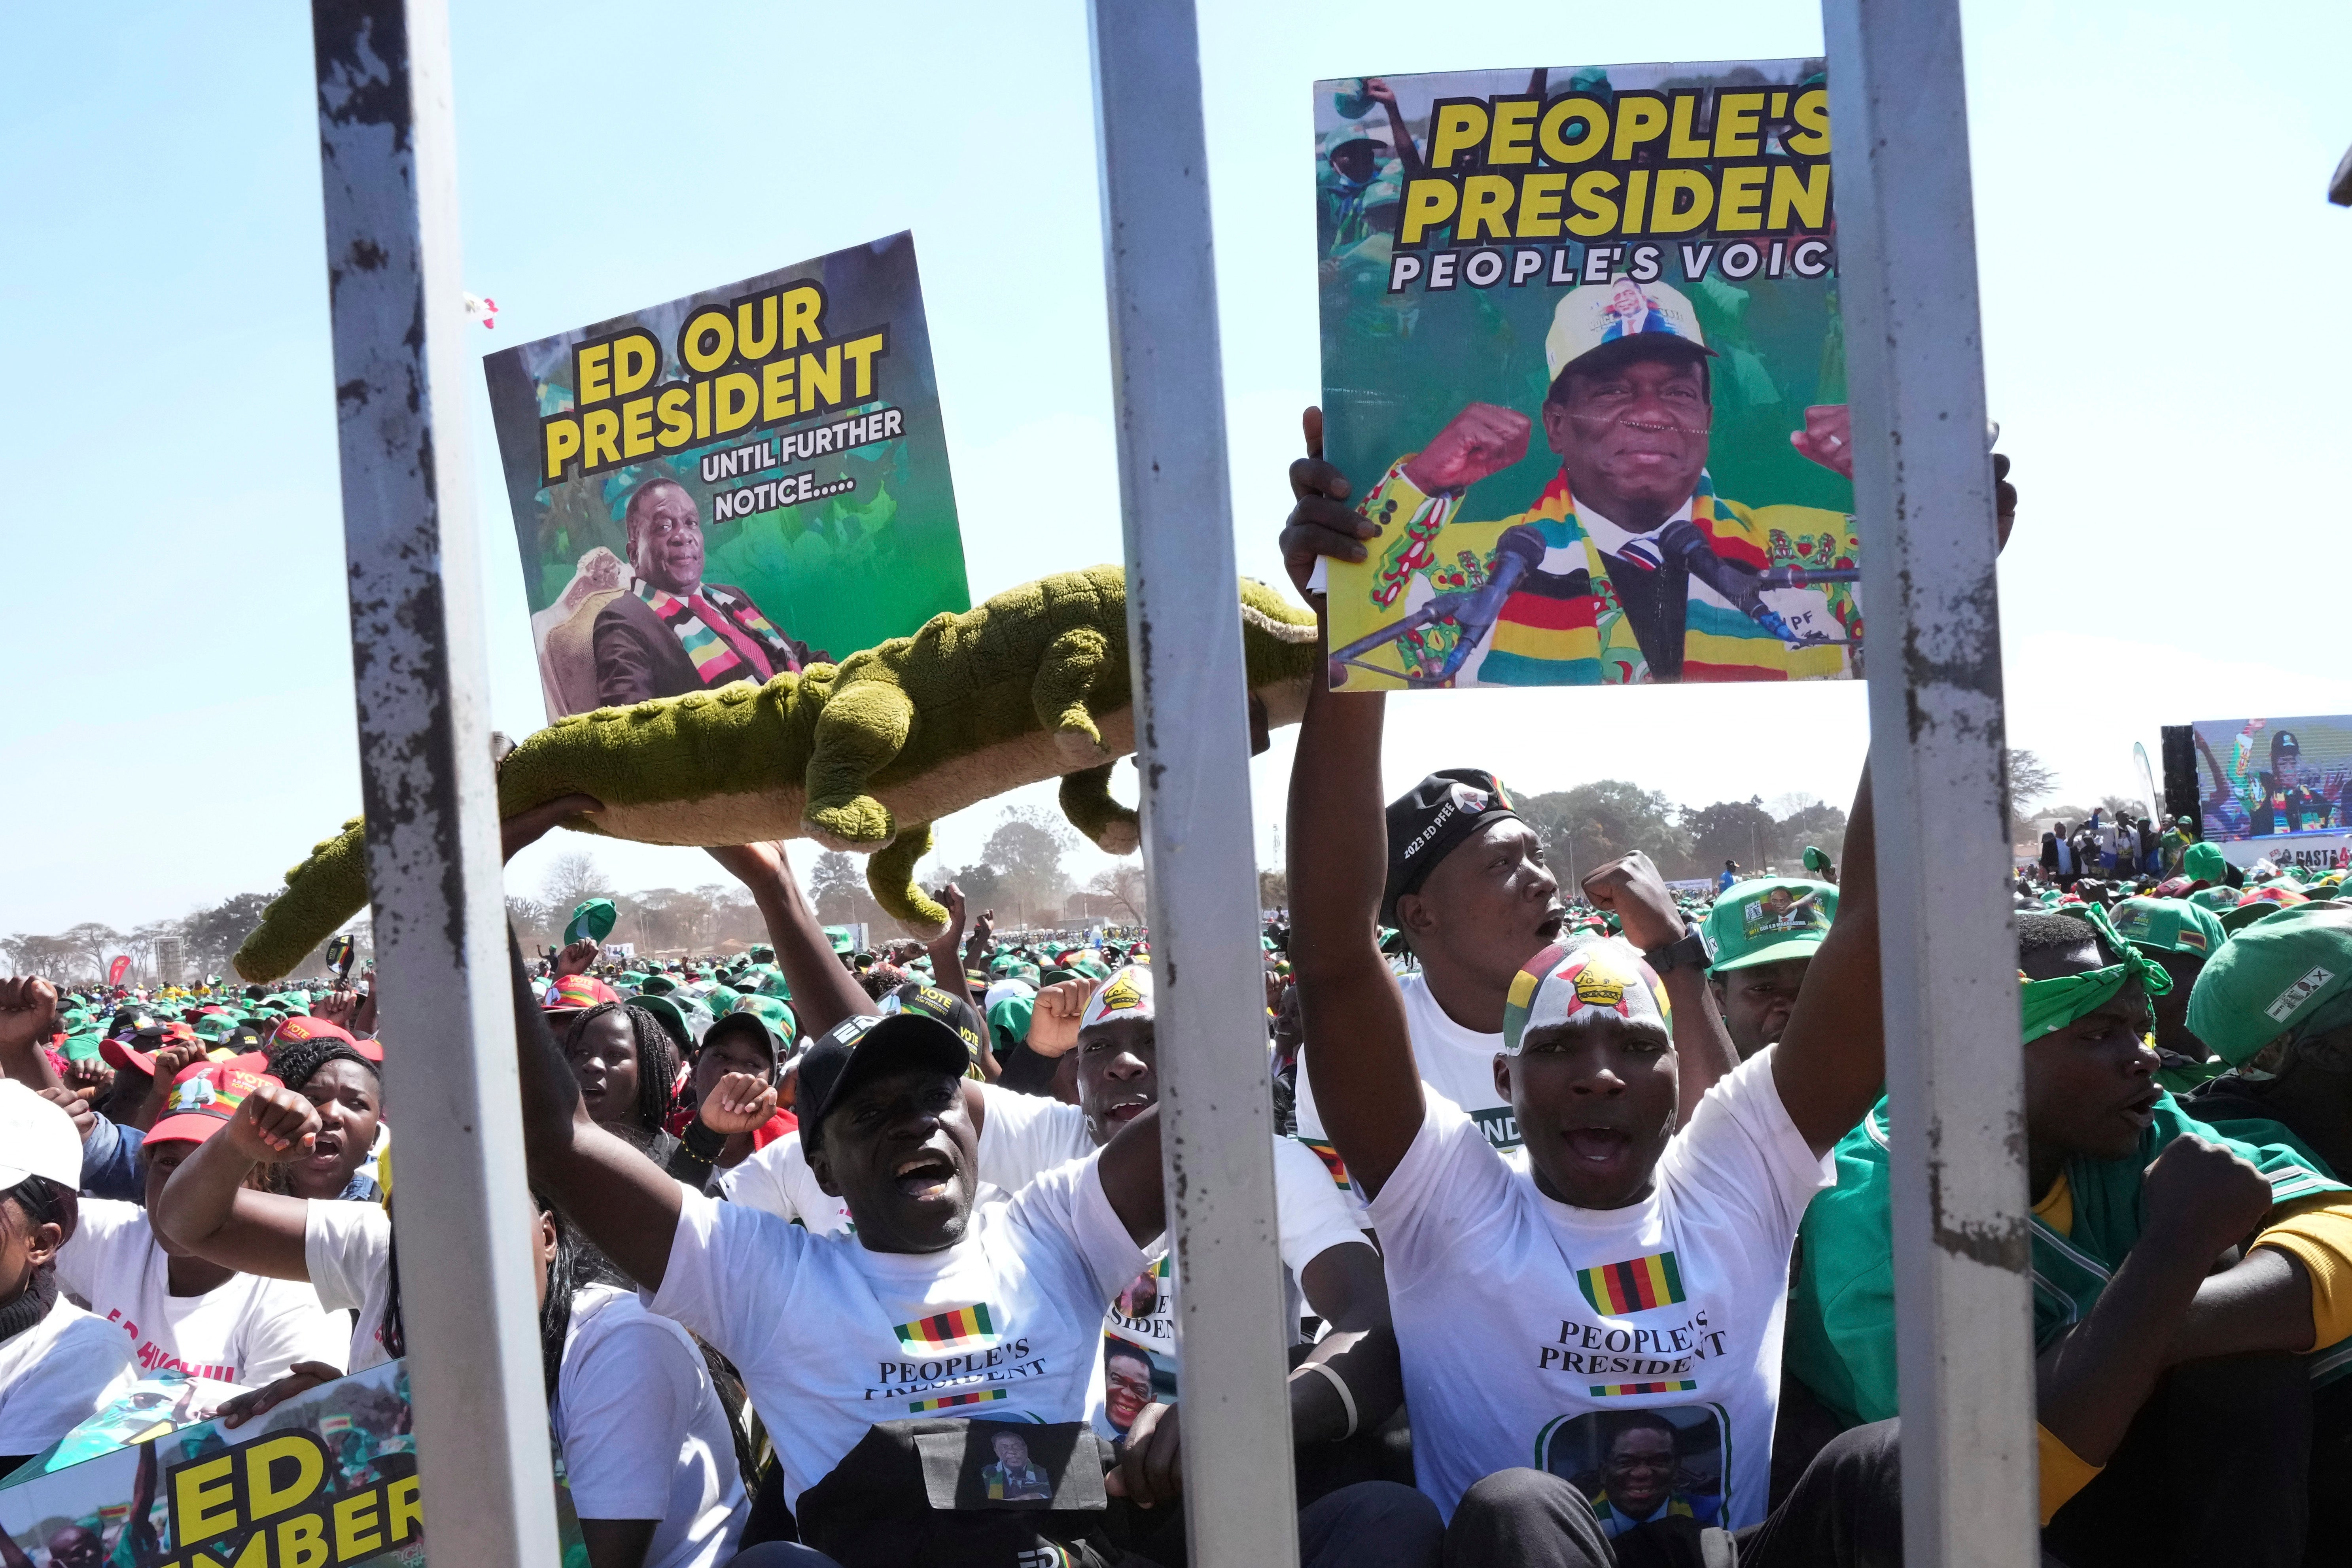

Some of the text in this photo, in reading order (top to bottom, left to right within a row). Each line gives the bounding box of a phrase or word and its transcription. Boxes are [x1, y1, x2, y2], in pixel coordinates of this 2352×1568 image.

[1432, 90, 1831, 168] PEOPLE'S
[1402, 165, 1830, 244] PRESIDEN
[1391, 241, 1839, 290] PEOPLE'S VOIC
[579, 286, 823, 405] ED OUR
[546, 333, 883, 478] PRESIDENT
[702, 409, 902, 482] UNTIL FURTHER
[715, 473, 854, 521] NOTICE.....
[1404, 802, 1455, 859] 2023 ED PFEE
[570, 977, 593, 986] VOTE
[920, 985, 953, 1009] VOTE
[287, 1021, 310, 1039] VOTE
[925, 1001, 948, 1017] PRESIDENT
[960, 1026, 979, 1047] VOTE
[1556, 1309, 1708, 1354] PEOPLE'S
[878, 1336, 1030, 1385] PEOPLE'S
[175, 1436, 324, 1547] ED
